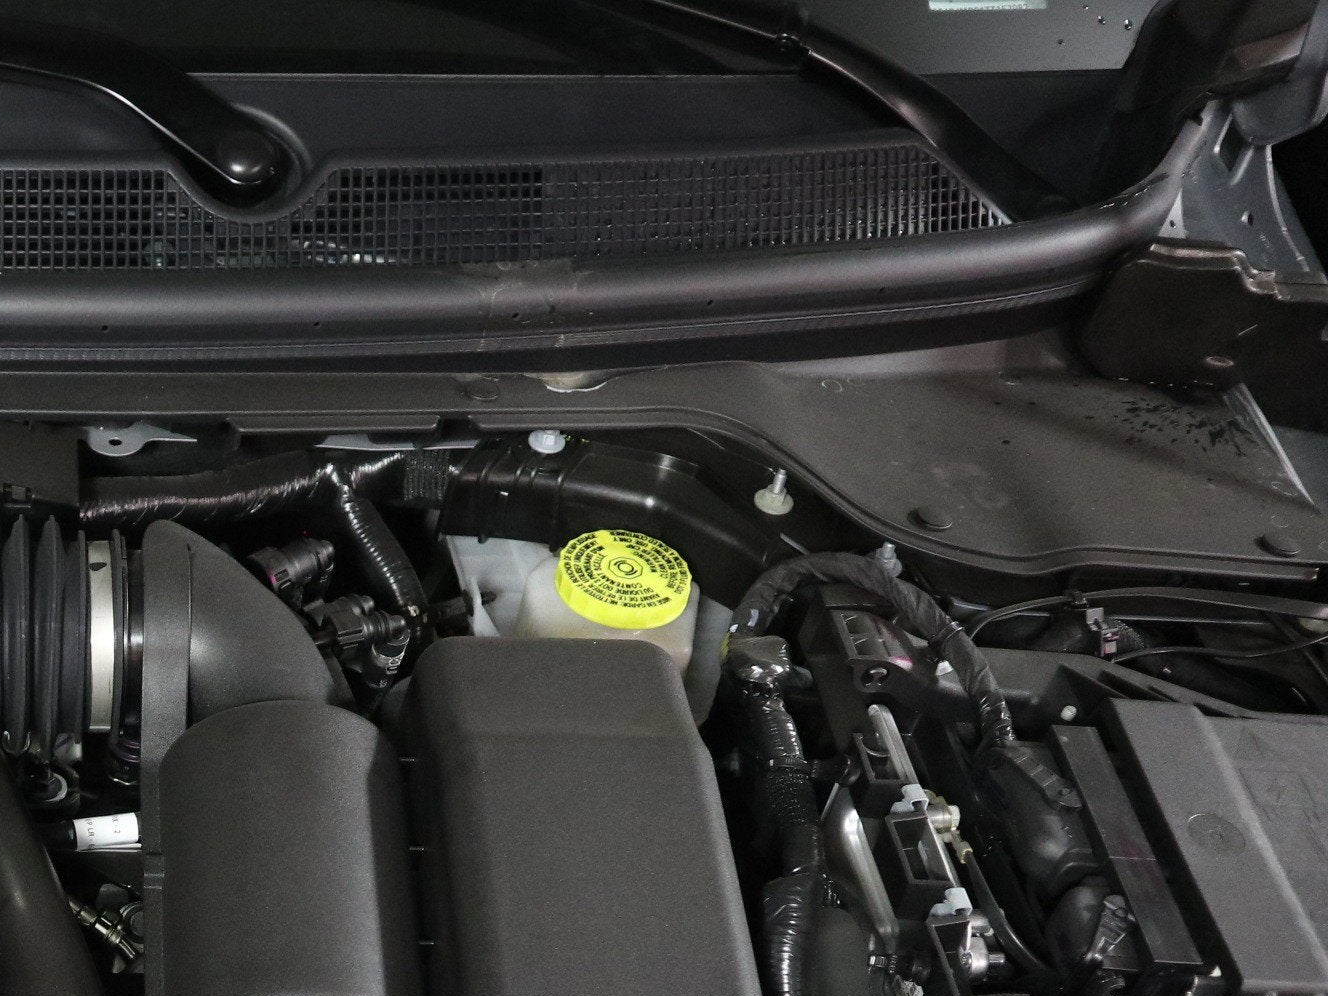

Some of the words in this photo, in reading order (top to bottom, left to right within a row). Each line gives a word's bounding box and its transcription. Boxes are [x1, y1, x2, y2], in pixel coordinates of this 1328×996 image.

[625, 543, 641, 551] CAP
[634, 539, 649, 548] USE
[646, 538, 672, 553] SEALED
[657, 563, 668, 579] CLEAN
[596, 572, 644, 589] CONTENANT
[581, 587, 618, 605] NETTOYER
[638, 592, 661, 601] AVANT
